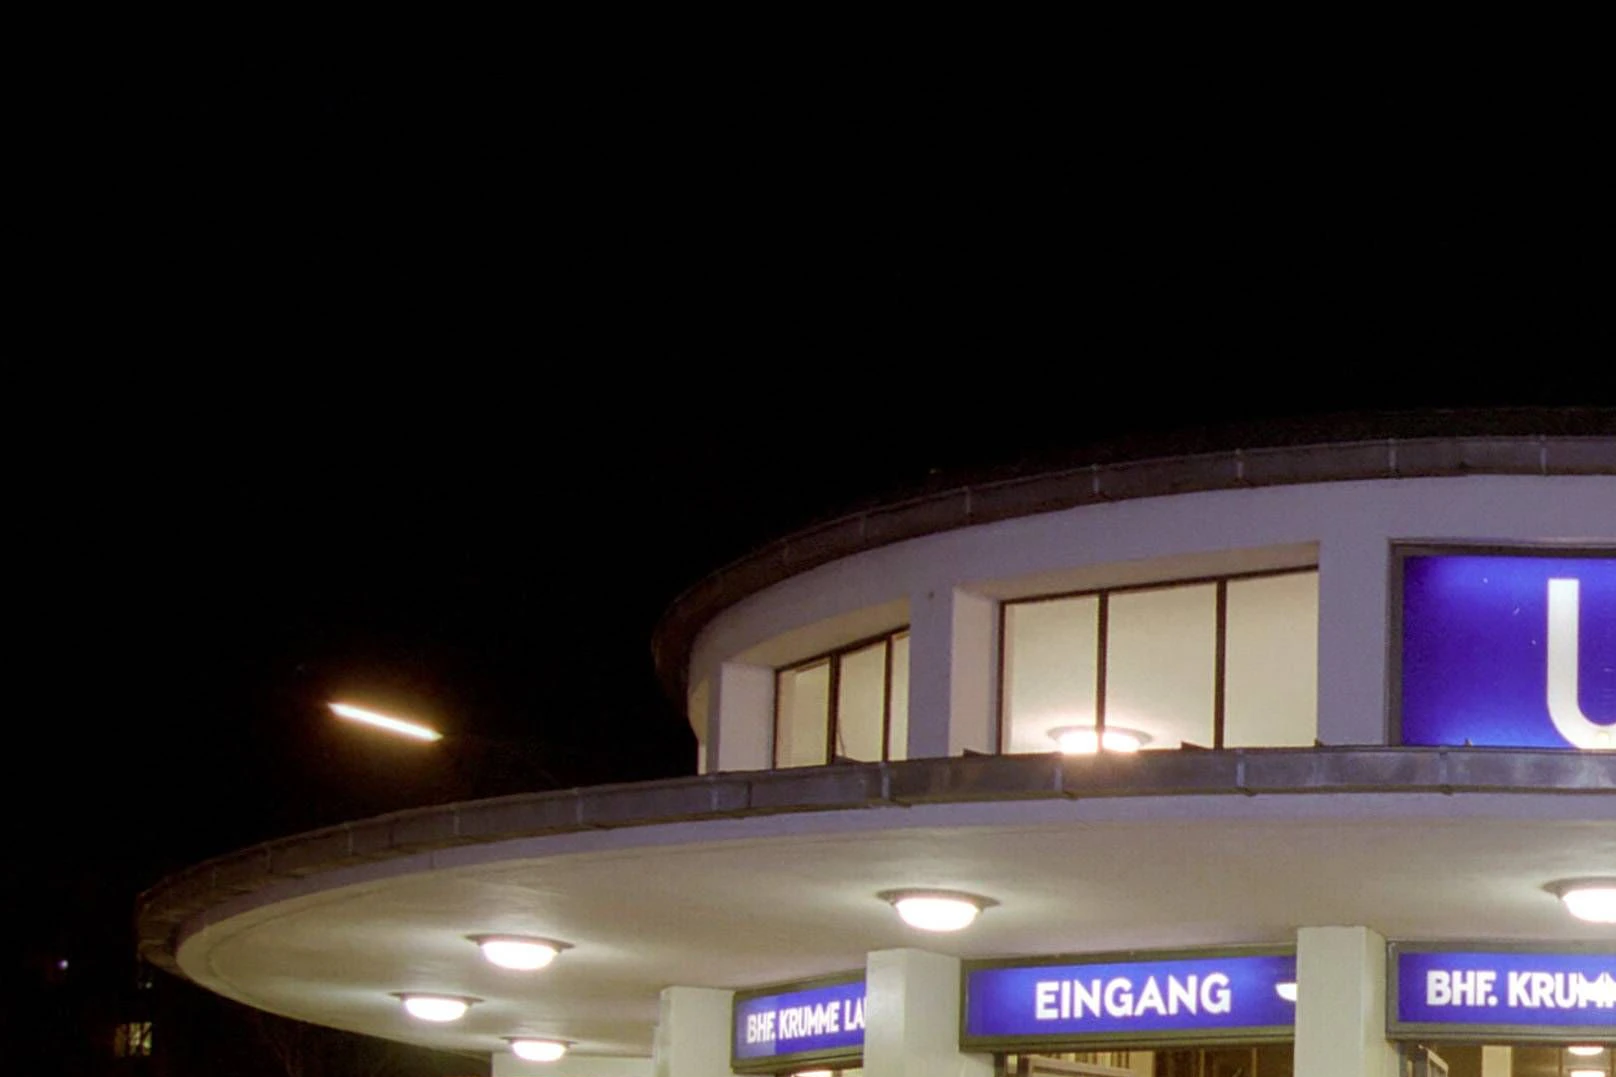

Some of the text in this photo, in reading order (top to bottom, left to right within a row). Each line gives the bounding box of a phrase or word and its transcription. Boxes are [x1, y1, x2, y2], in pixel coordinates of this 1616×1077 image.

[1035, 972, 1232, 1020] EINGANG
[1426, 971, 1498, 1006] BHF.
[746, 1010, 776, 1044] BHF.
[778, 1001, 841, 1041] KRUMME
